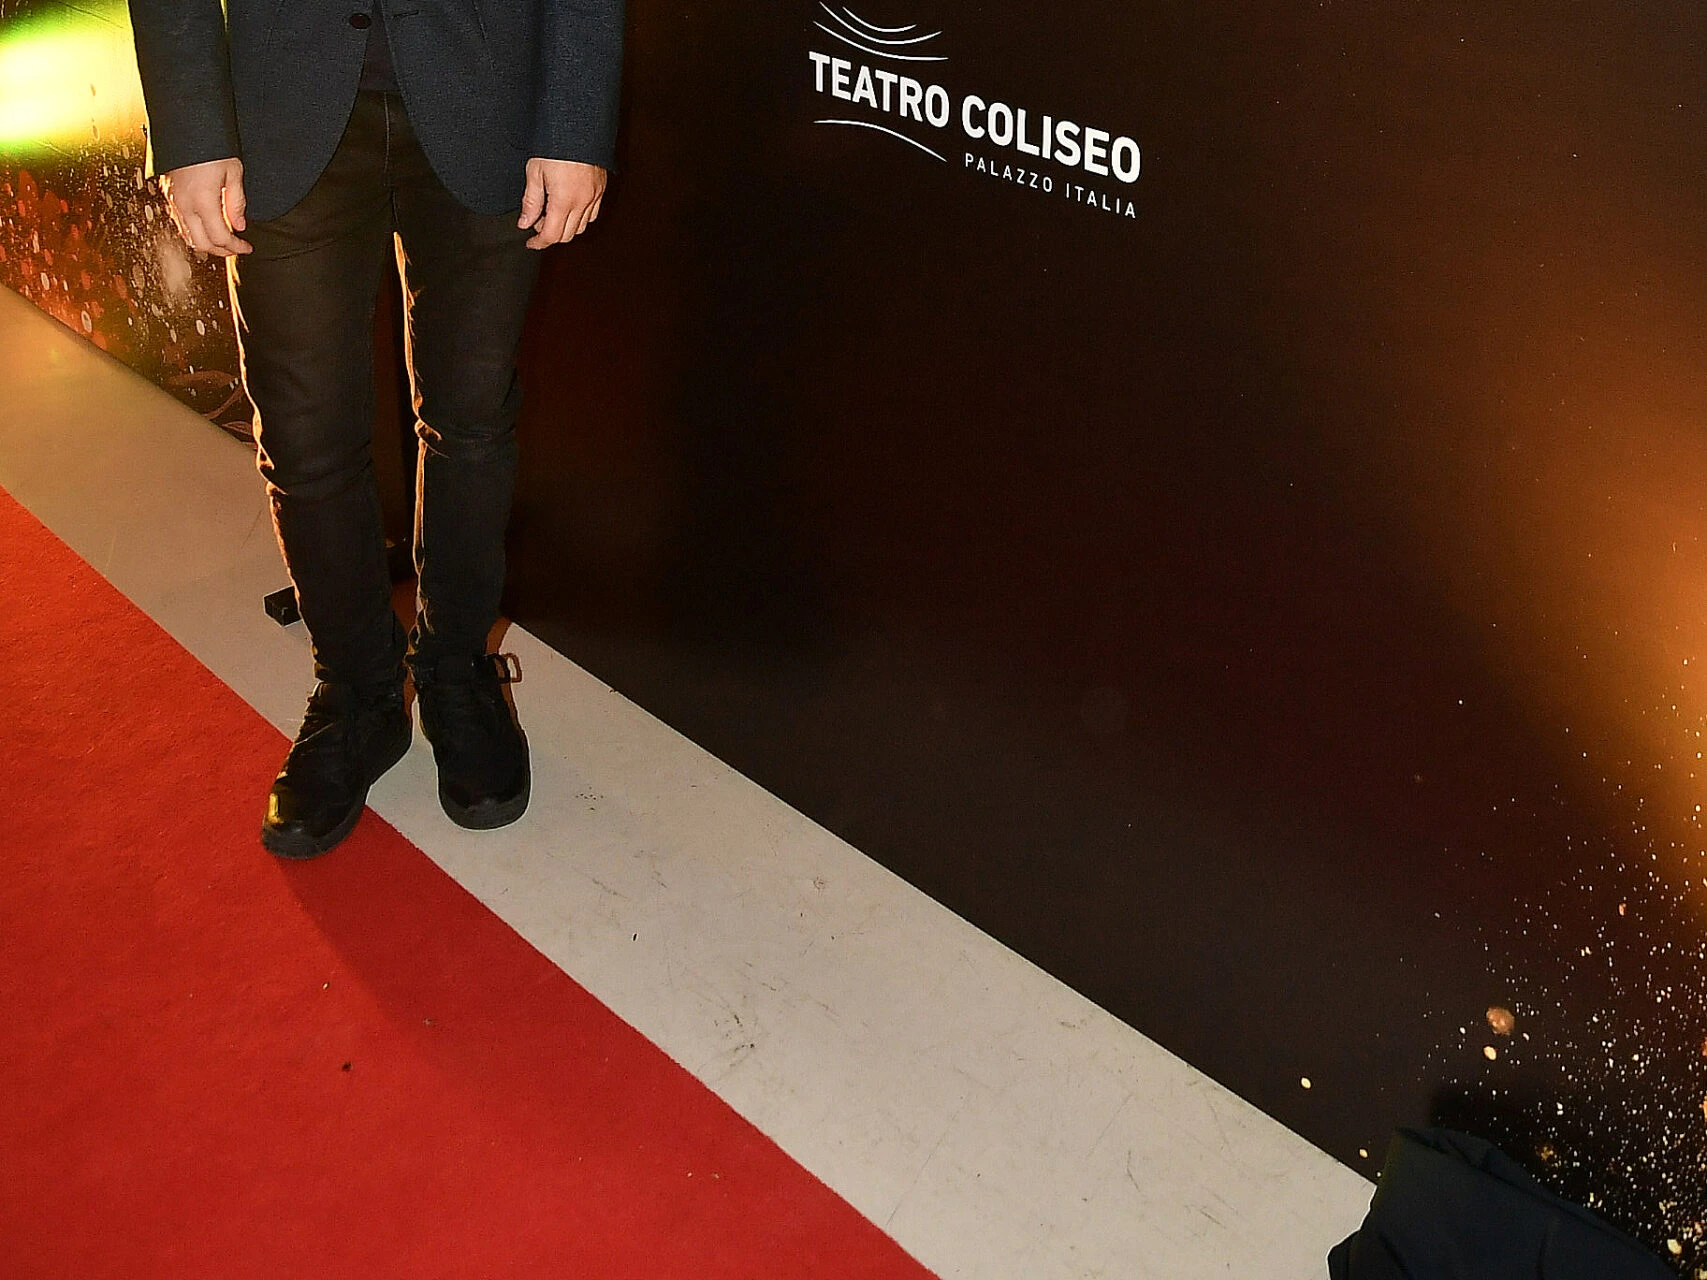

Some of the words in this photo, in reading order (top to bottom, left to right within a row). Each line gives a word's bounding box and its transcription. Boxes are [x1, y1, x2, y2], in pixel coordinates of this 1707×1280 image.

[808, 50, 950, 129] TEATRO
[961, 94, 1142, 184] COLISEO
[964, 152, 1053, 193] PALAZZO
[1065, 182, 1137, 219] ITALIA
